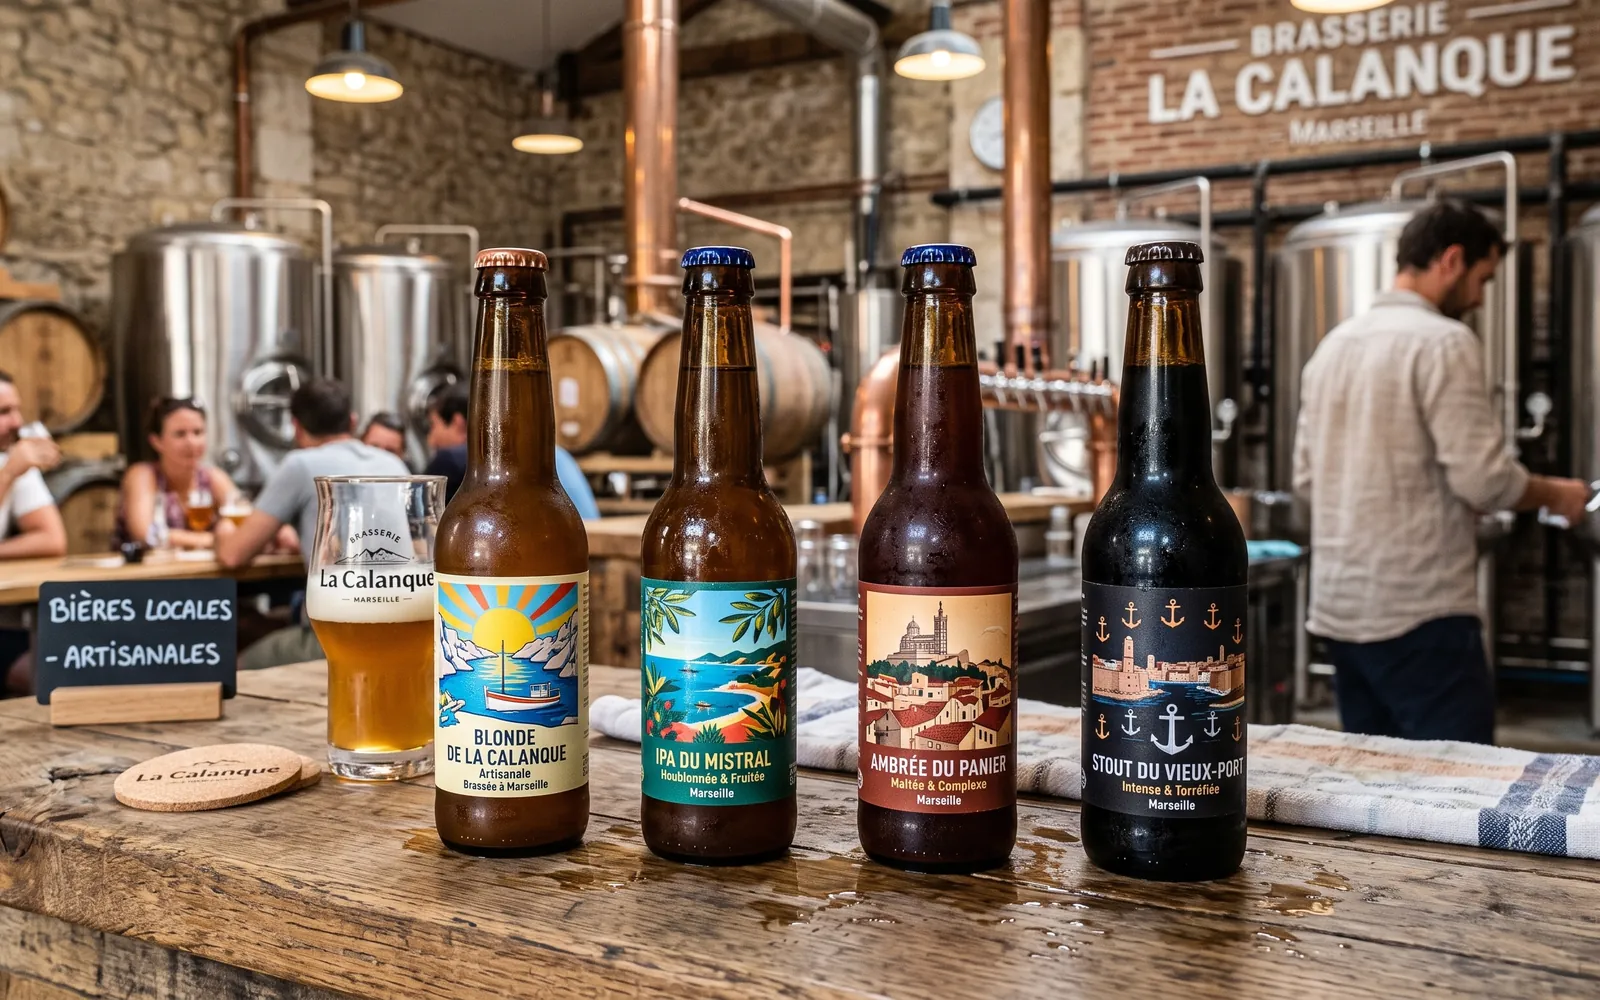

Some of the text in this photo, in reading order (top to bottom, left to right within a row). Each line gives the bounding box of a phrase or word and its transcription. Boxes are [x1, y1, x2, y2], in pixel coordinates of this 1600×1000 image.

[1250, 2, 1450, 57] BRASSERIE
[1148, 25, 1576, 124] LA CALANQUE
[1289, 109, 1428, 145] MARSEILLE
[349, 528, 401, 544] BRASSERIE
[320, 569, 434, 592] La Calanque
[145, 599, 232, 621] LOCALES
[474, 729, 536, 746] BLONDE
[447, 745, 461, 762] DE
[465, 748, 483, 765] LA
[487, 745, 567, 766] CALANQUE
[656, 748, 771, 770] IPA DU MISTRAL
[870, 753, 1006, 777] AMBRÉE DU PANIER
[1092, 753, 1244, 781] STOUT DU VIEUX-PORT
[136, 766, 281, 782] La Calanque
[479, 768, 531, 779] Artisanale
[661, 769, 765, 784] Houblonnée & Fruitée
[463, 780, 549, 791] Brassée à Marseille
[690, 788, 734, 798] Marseille
[891, 777, 987, 793] Maltée & Complexe
[1122, 781, 1220, 796] Intense & Torréfiée
[916, 795, 962, 806] Marseille
[1148, 799, 1195, 811] Marseille
